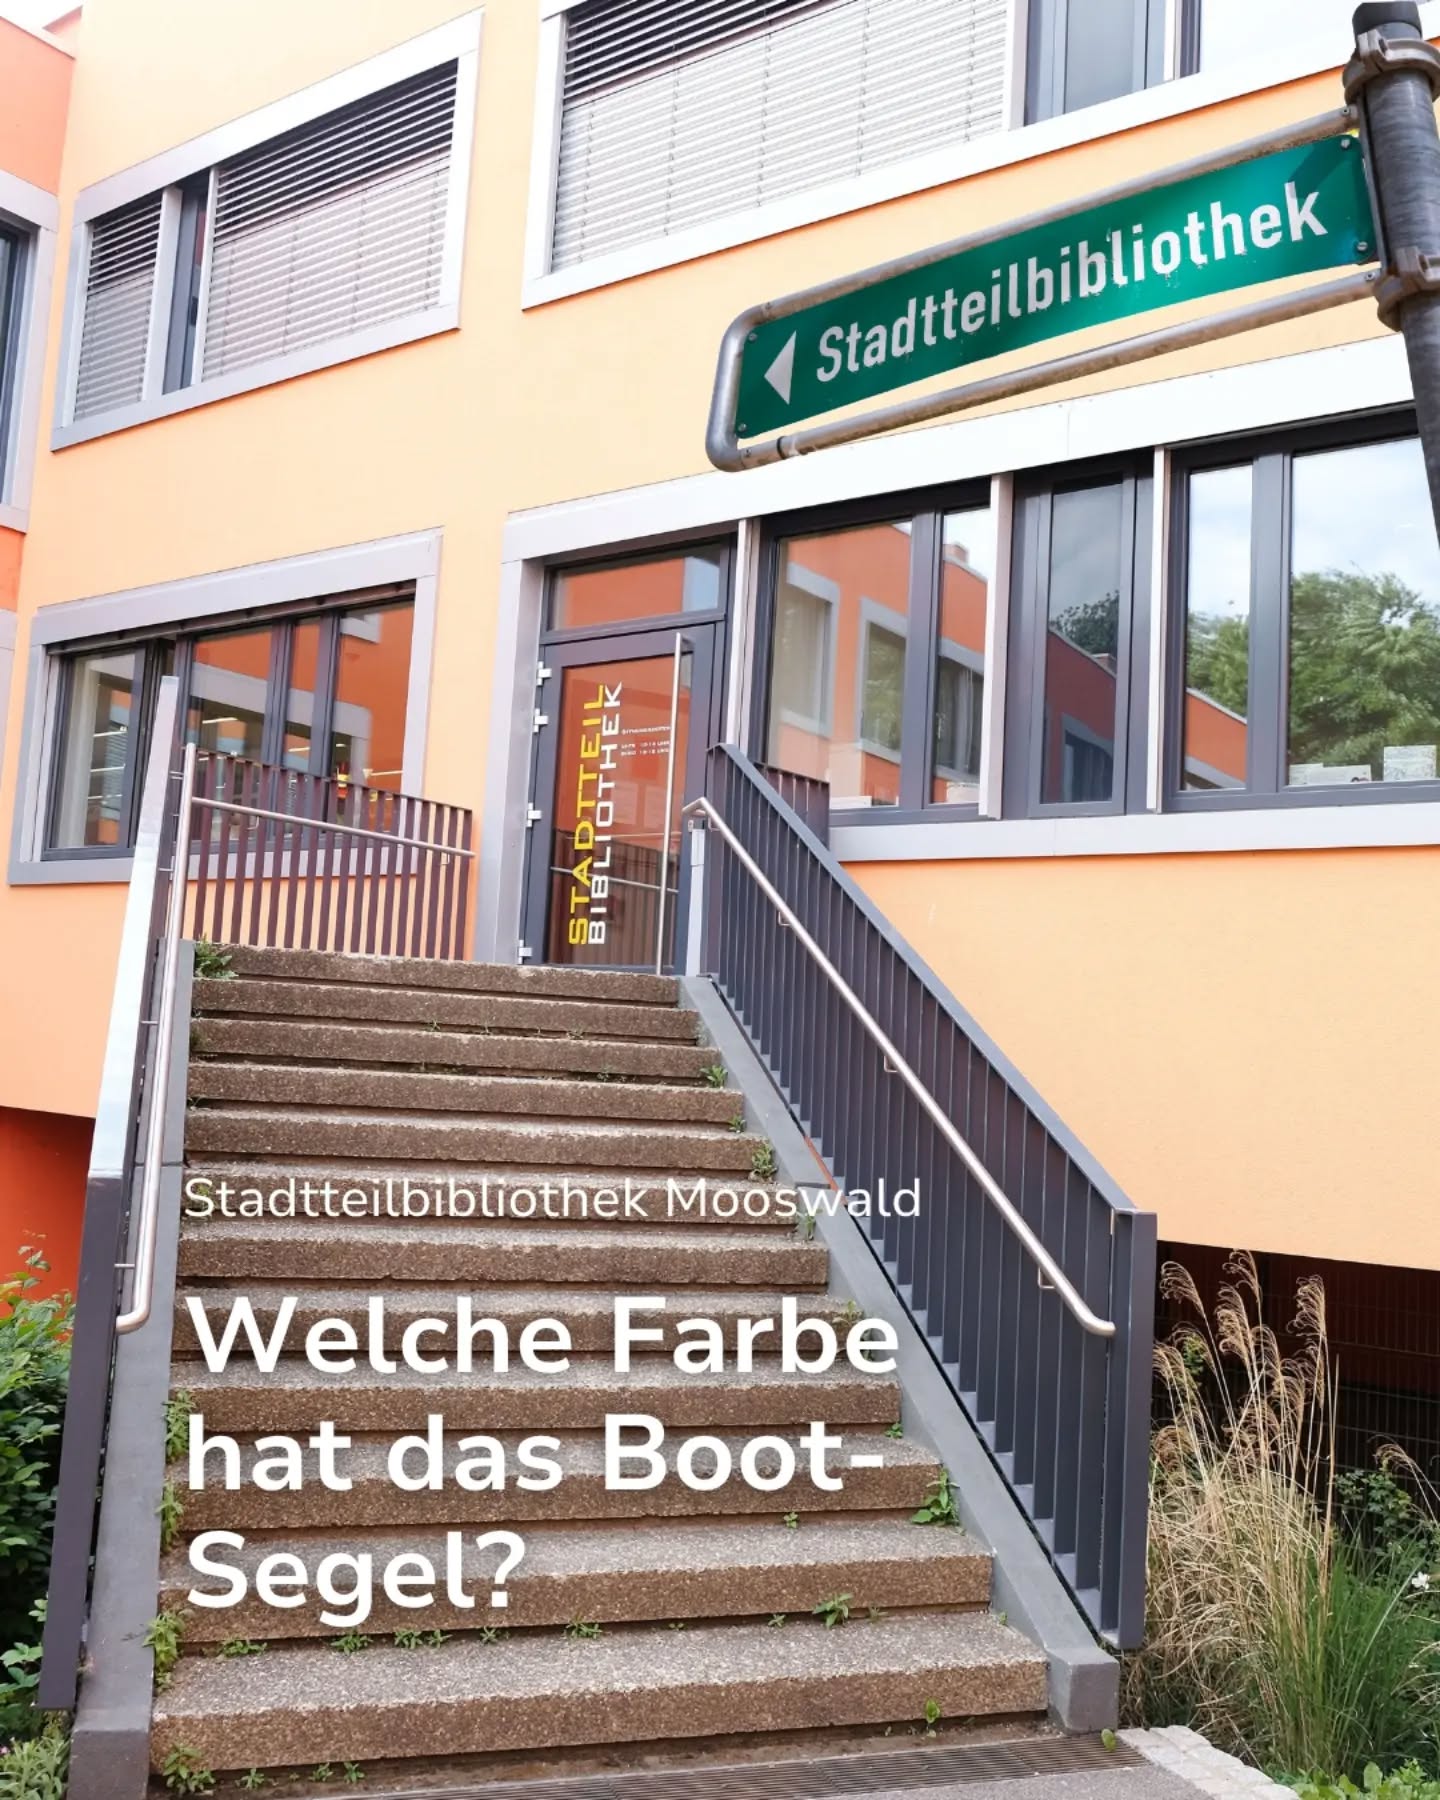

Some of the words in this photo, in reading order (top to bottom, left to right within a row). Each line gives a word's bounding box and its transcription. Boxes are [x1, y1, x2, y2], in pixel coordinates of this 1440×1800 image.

[815, 181, 1328, 383] Stadtteilbibliothek
[568, 684, 604, 945] STADTTEIL
[588, 681, 622, 945] BIBLIOTHEK
